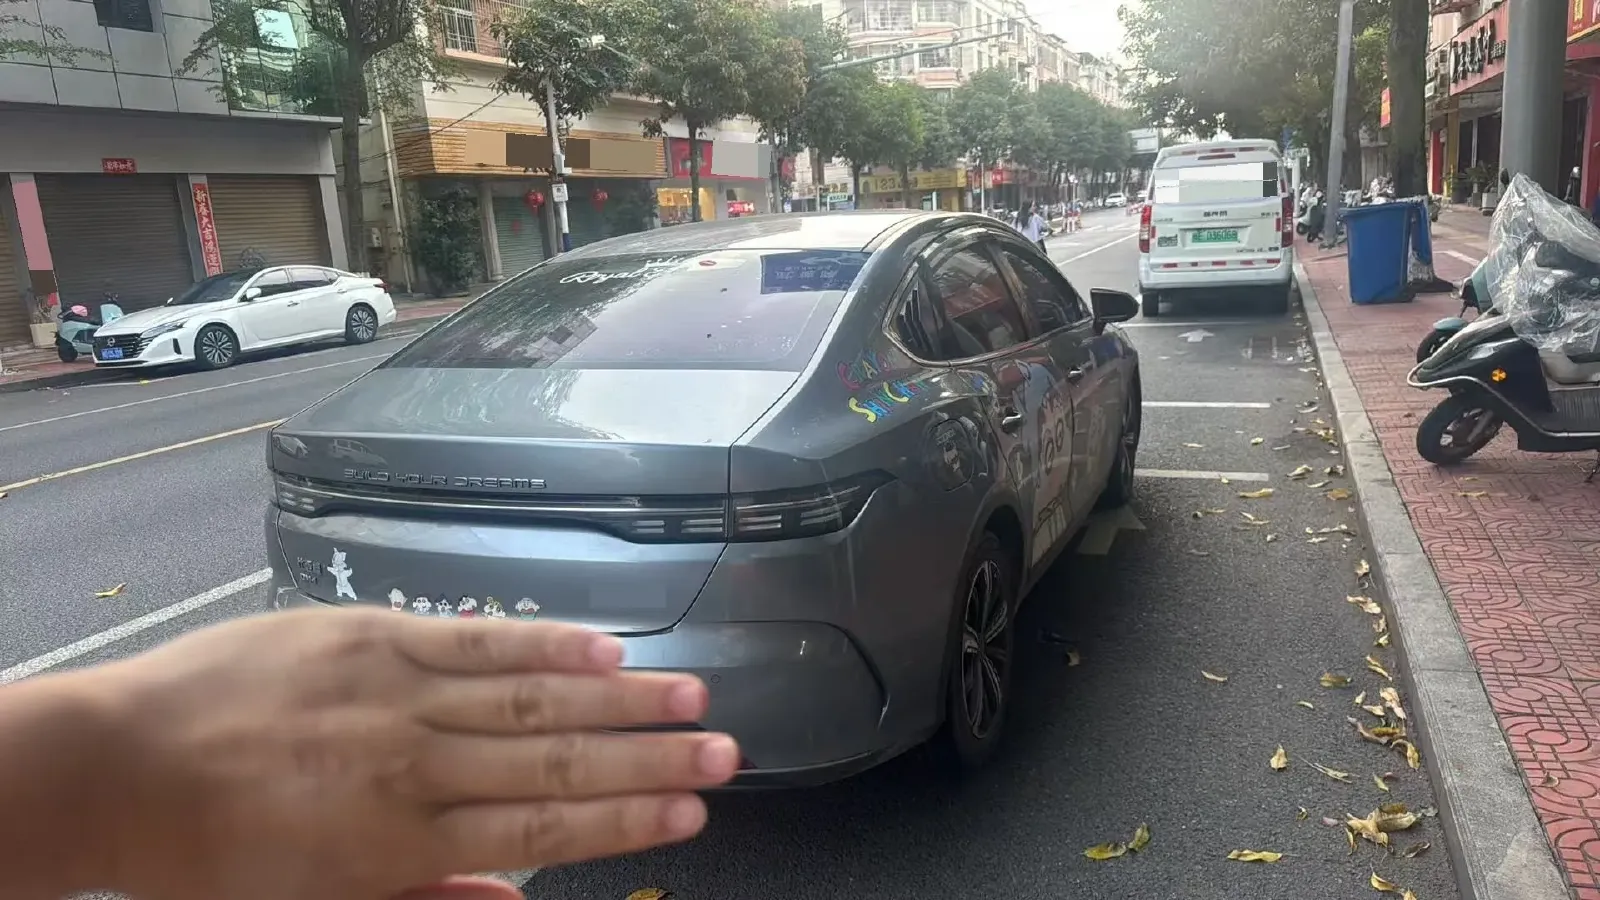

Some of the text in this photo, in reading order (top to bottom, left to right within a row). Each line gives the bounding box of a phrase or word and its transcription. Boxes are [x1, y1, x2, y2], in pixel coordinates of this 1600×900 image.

[343, 468, 547, 489] BUILD YOUR DREAMS
